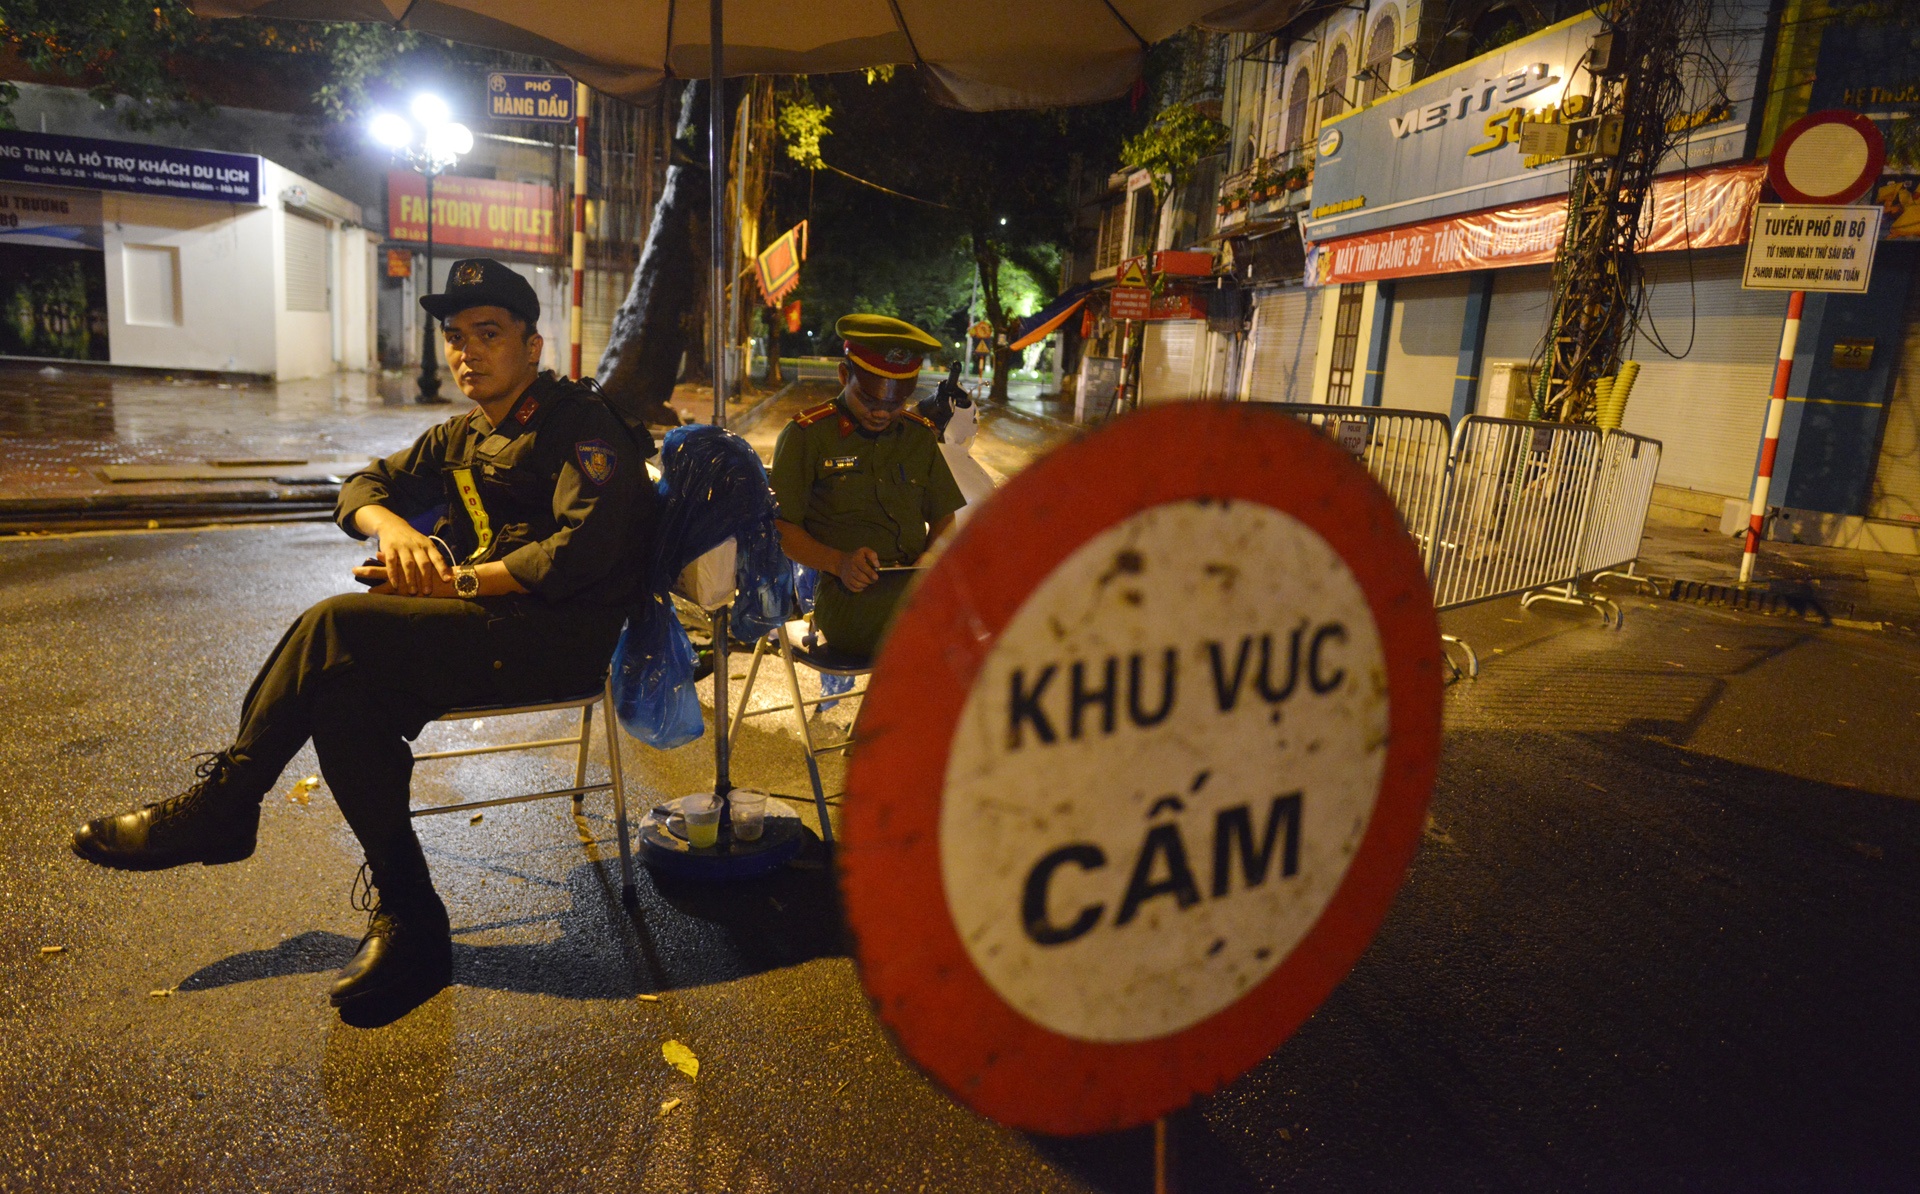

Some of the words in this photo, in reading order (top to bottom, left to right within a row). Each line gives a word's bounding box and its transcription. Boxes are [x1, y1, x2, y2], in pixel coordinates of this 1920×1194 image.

[525, 79, 551, 92] PHỐ
[493, 92, 535, 116] HÀNG
[24, 147, 51, 161] TIN
[54, 149, 76, 164] VÀ
[103, 156, 136, 172] TRỢ
[138, 159, 190, 176] KHÁCH
[193, 165, 213, 179] DU
[216, 168, 249, 183] LỊCH
[401, 194, 484, 230] FACTORY
[488, 203, 553, 236] OUTLET
[1765, 215, 1803, 236] TUYẾN
[1806, 215, 1833, 237] PHỐ
[1833, 220, 1846, 237] ĐI
[1848, 217, 1866, 241] BỘ
[1335, 243, 1354, 275] MÁY
[1355, 235, 1380, 272] TÍNH
[1378, 231, 1406, 270] BẢNG
[1407, 235, 1423, 266] 3G
[1776, 246, 1795, 258] 19H00
[1796, 244, 1814, 259] NGÀY
[1828, 245, 1840, 259] SÁU
[1753, 267, 1773, 278] 24H00
[1773, 265, 1791, 279] NGÀY
[1806, 266, 1824, 282] NHẬT
[1824, 266, 1842, 281] HÀNG
[1844, 346, 1861, 358] 26
[1343, 437, 1361, 449] STOP
[1007, 648, 1178, 751] KHU
[1205, 617, 1349, 728] VỰC
[1020, 770, 1305, 947] CẤM
